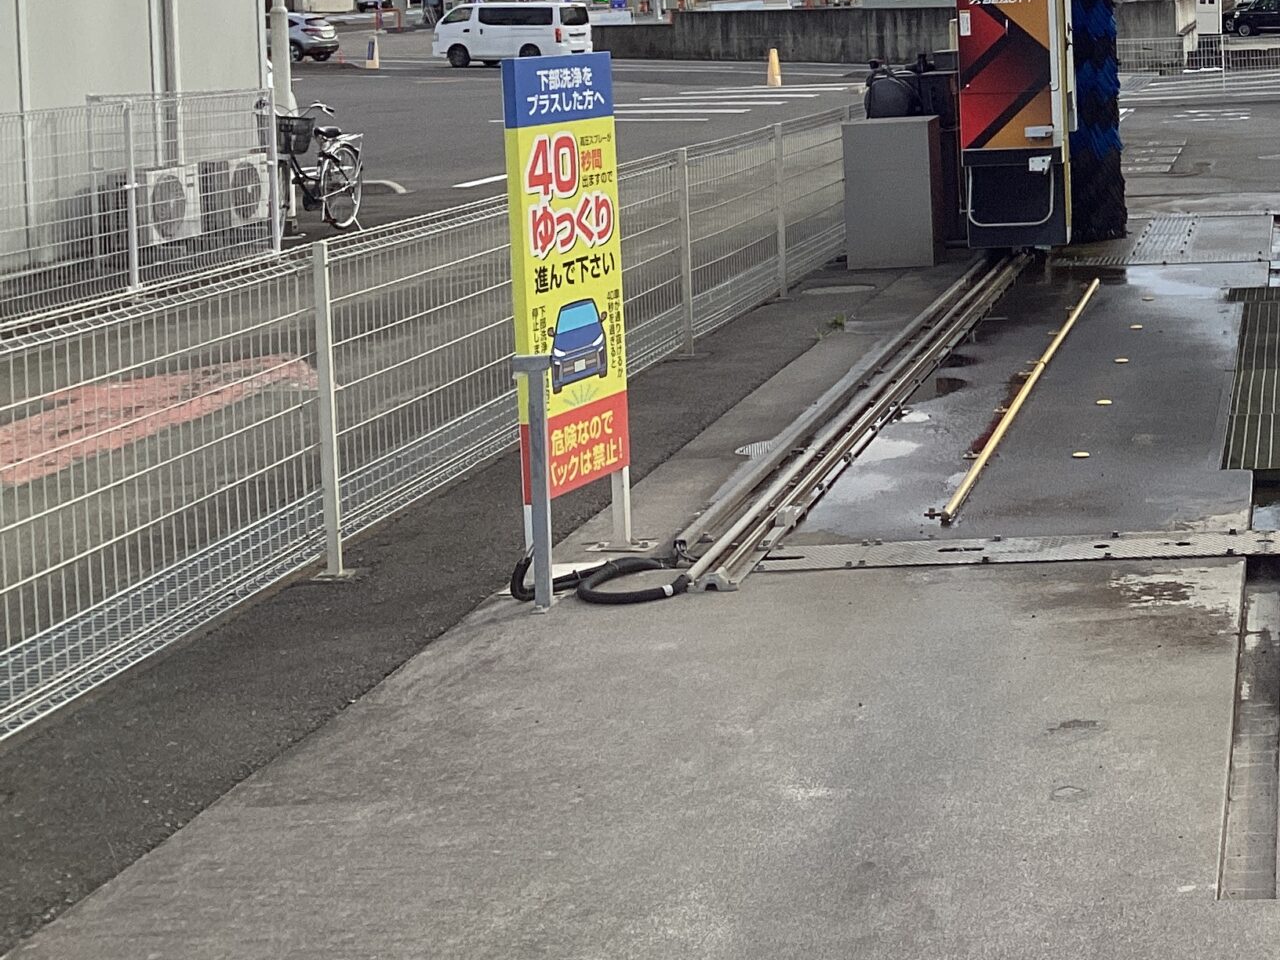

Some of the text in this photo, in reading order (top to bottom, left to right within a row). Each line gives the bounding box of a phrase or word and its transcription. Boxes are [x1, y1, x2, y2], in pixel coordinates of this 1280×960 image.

[536, 66, 593, 91] 下部洗浄を
[526, 88, 605, 116] プラスした方へ
[528, 135, 577, 196] 40
[580, 148, 603, 172] 秒間
[581, 170, 614, 188] 出ますので
[530, 194, 613, 254] ゆっくり
[534, 251, 615, 295] 進んで下さい
[550, 409, 614, 457] 危険なので
